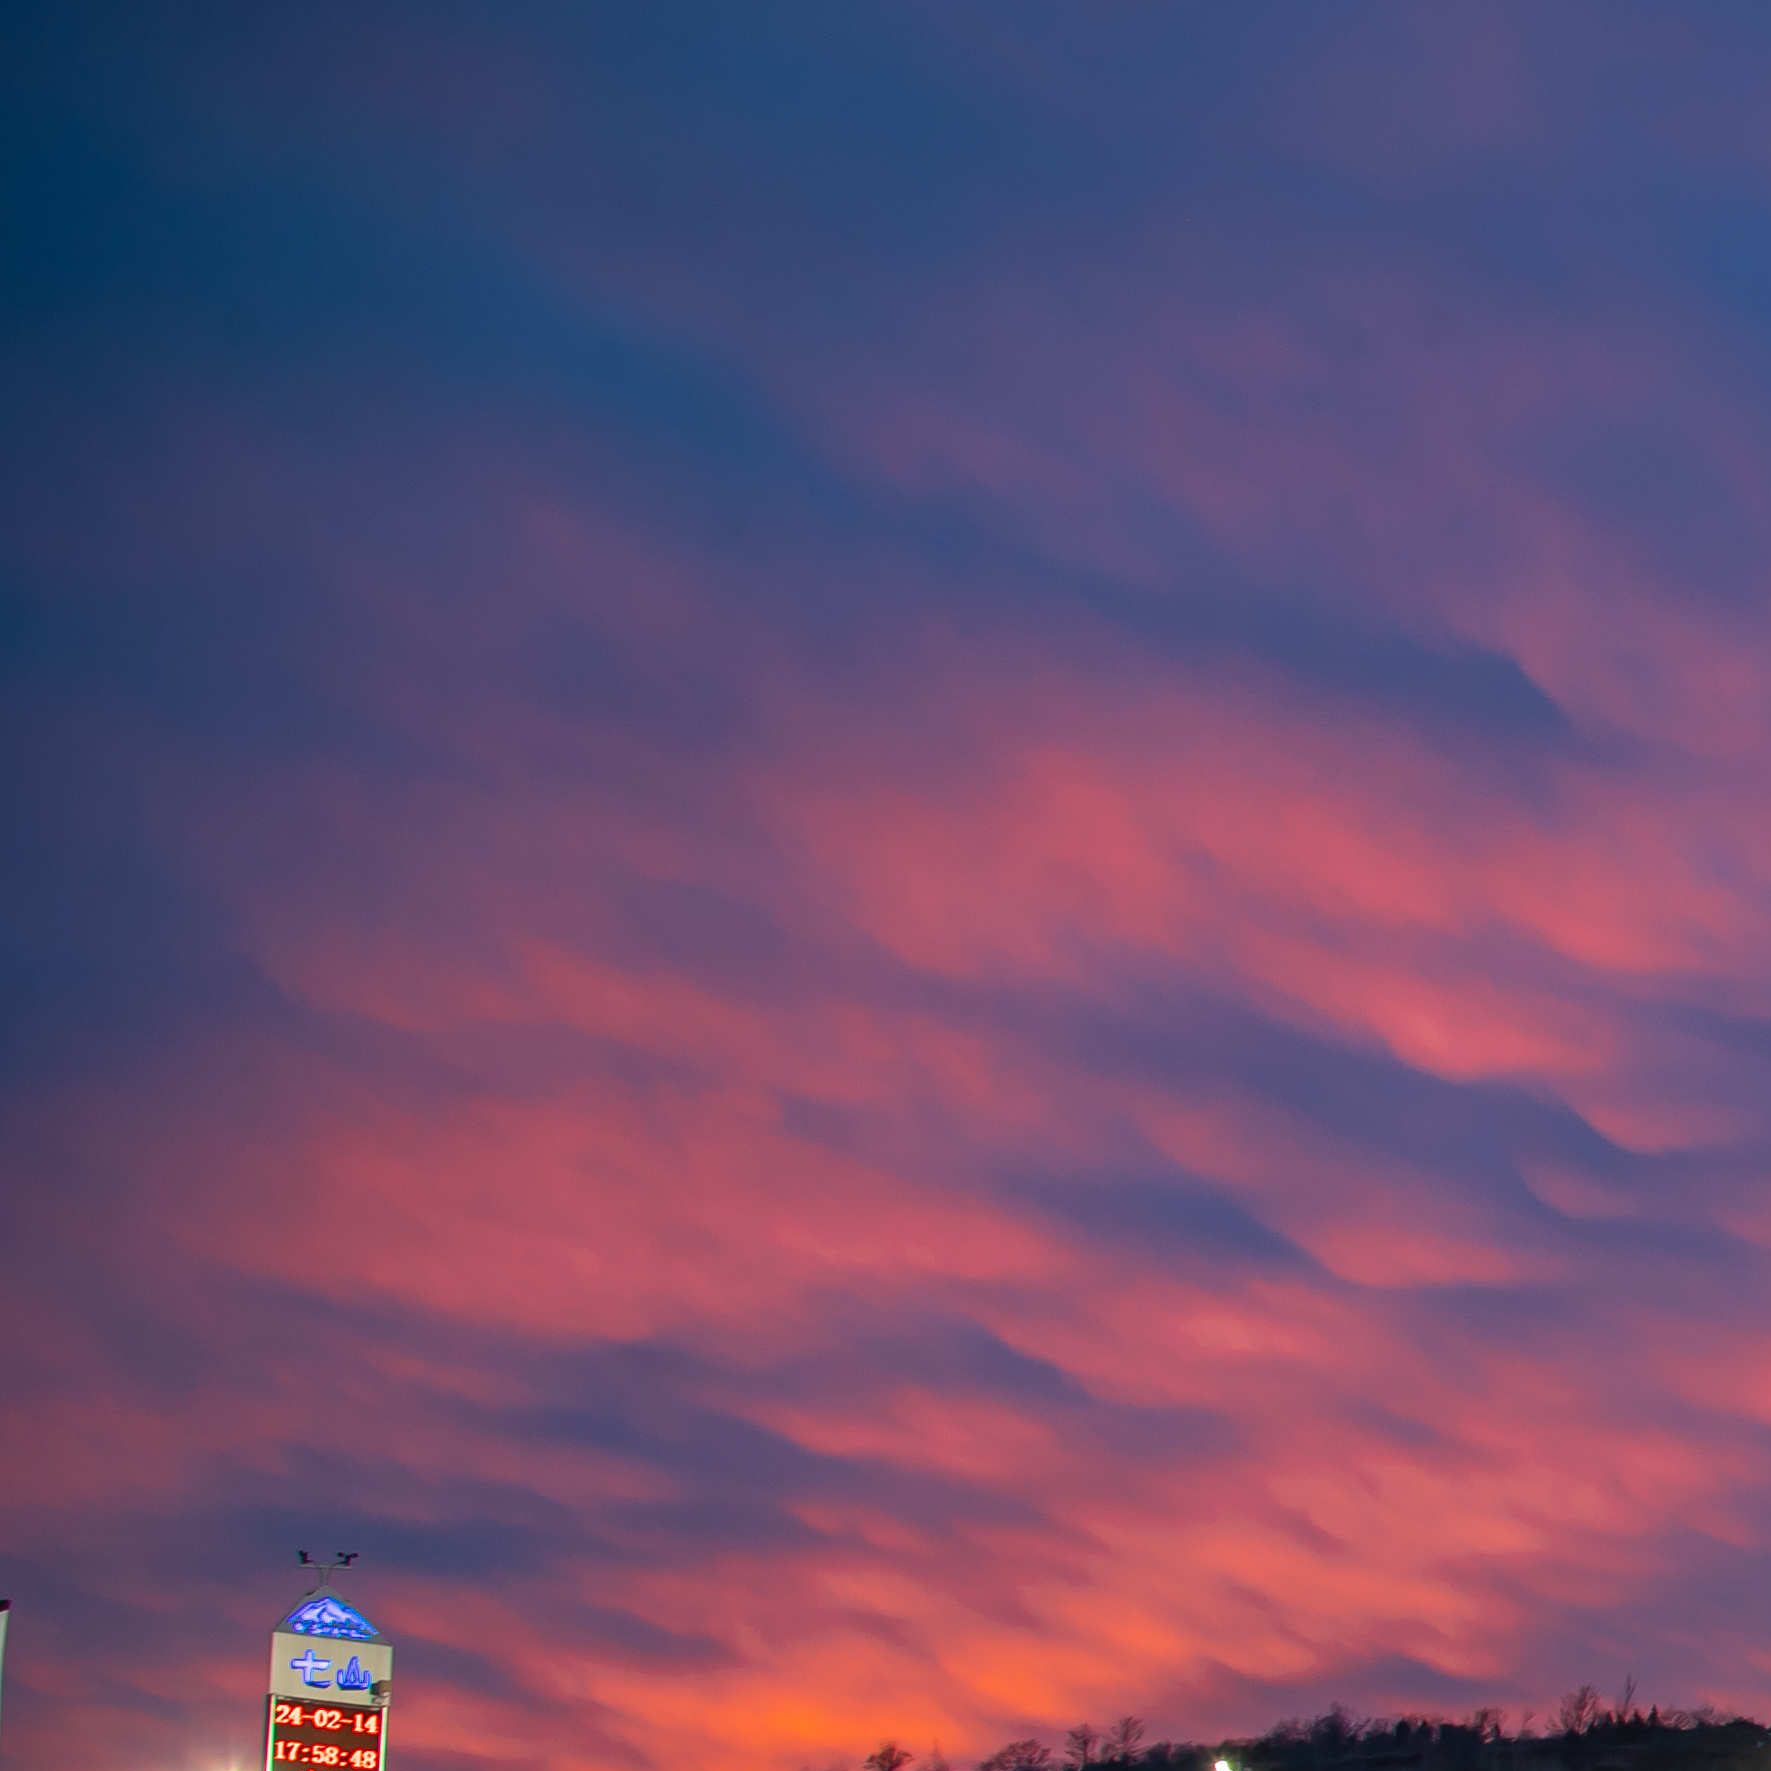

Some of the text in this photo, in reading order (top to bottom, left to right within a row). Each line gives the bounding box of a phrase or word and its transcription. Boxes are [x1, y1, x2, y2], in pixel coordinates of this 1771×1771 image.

[290, 1649, 370, 1690] 七山
[274, 1704, 379, 1734] 24-02-14
[274, 1740, 377, 1769] 17:58:48
